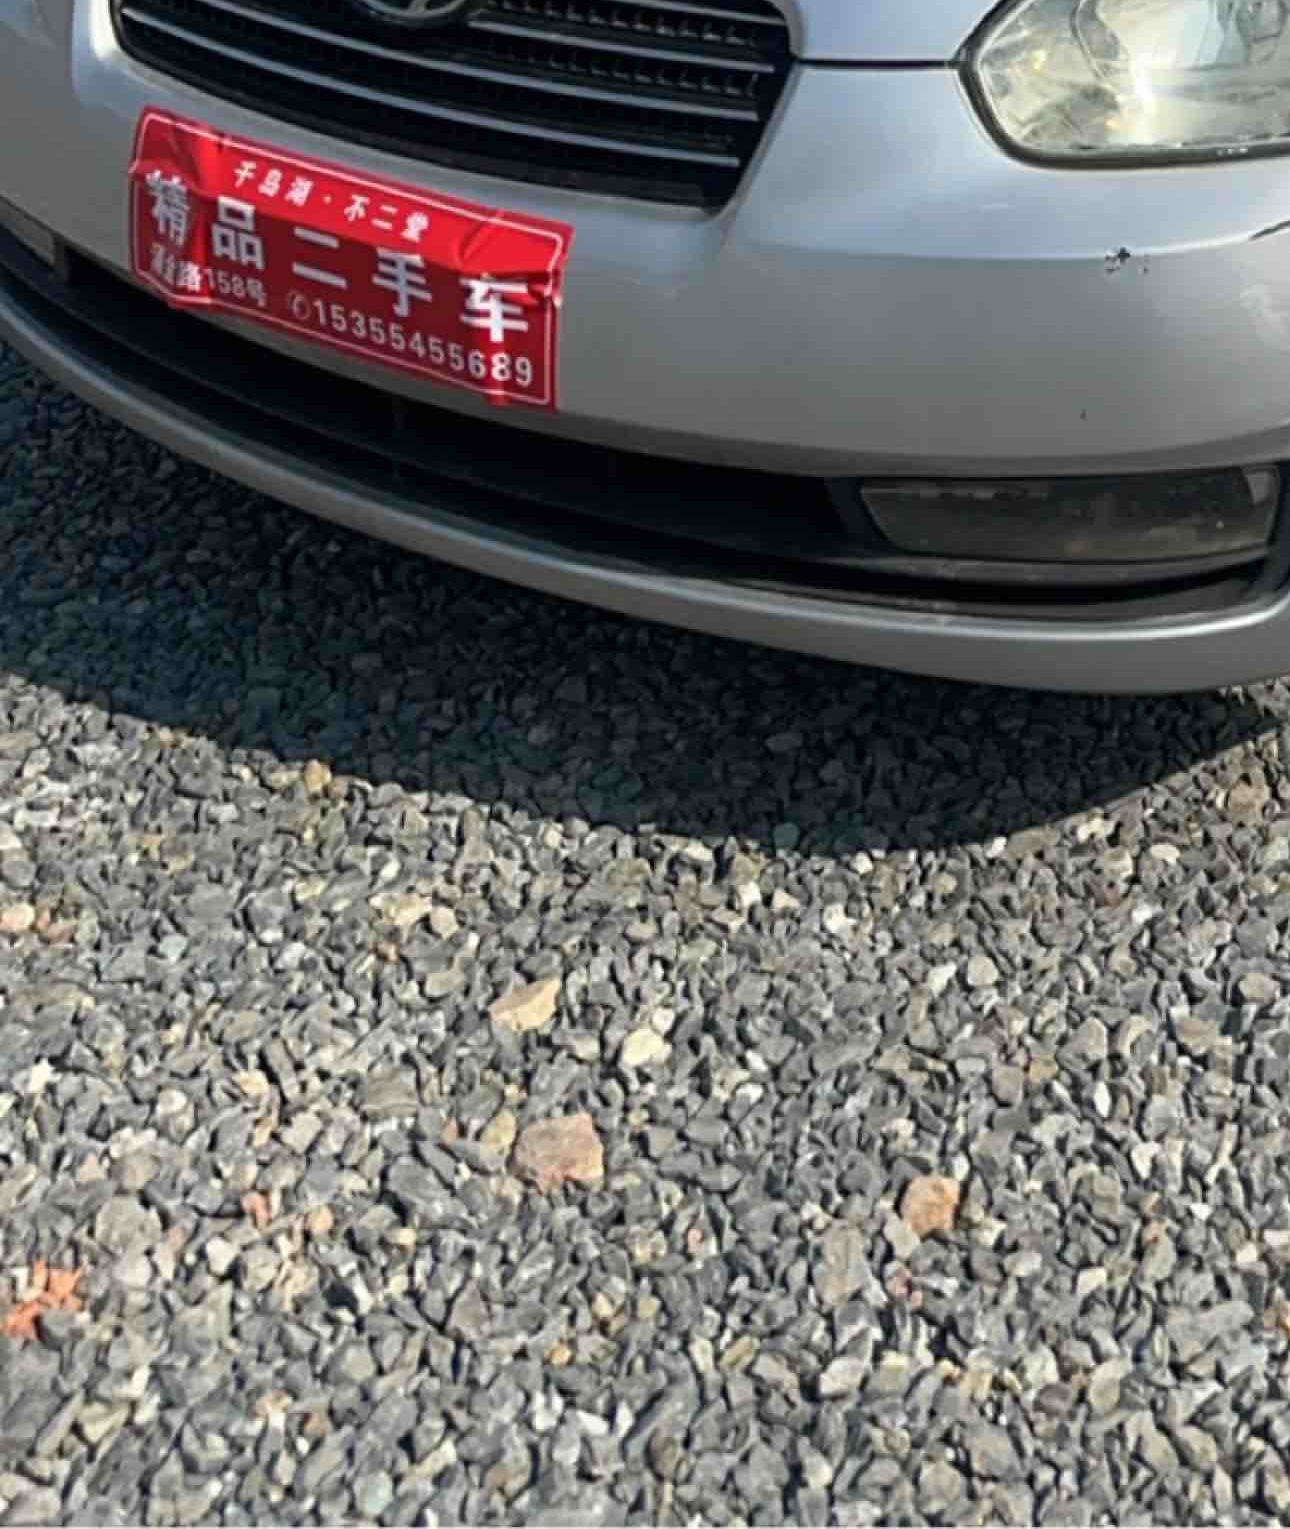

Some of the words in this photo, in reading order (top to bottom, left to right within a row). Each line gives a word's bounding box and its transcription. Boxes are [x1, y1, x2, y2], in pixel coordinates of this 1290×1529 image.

[144, 169, 531, 344] 精品二手车
[313, 298, 533, 388] 15355455689
